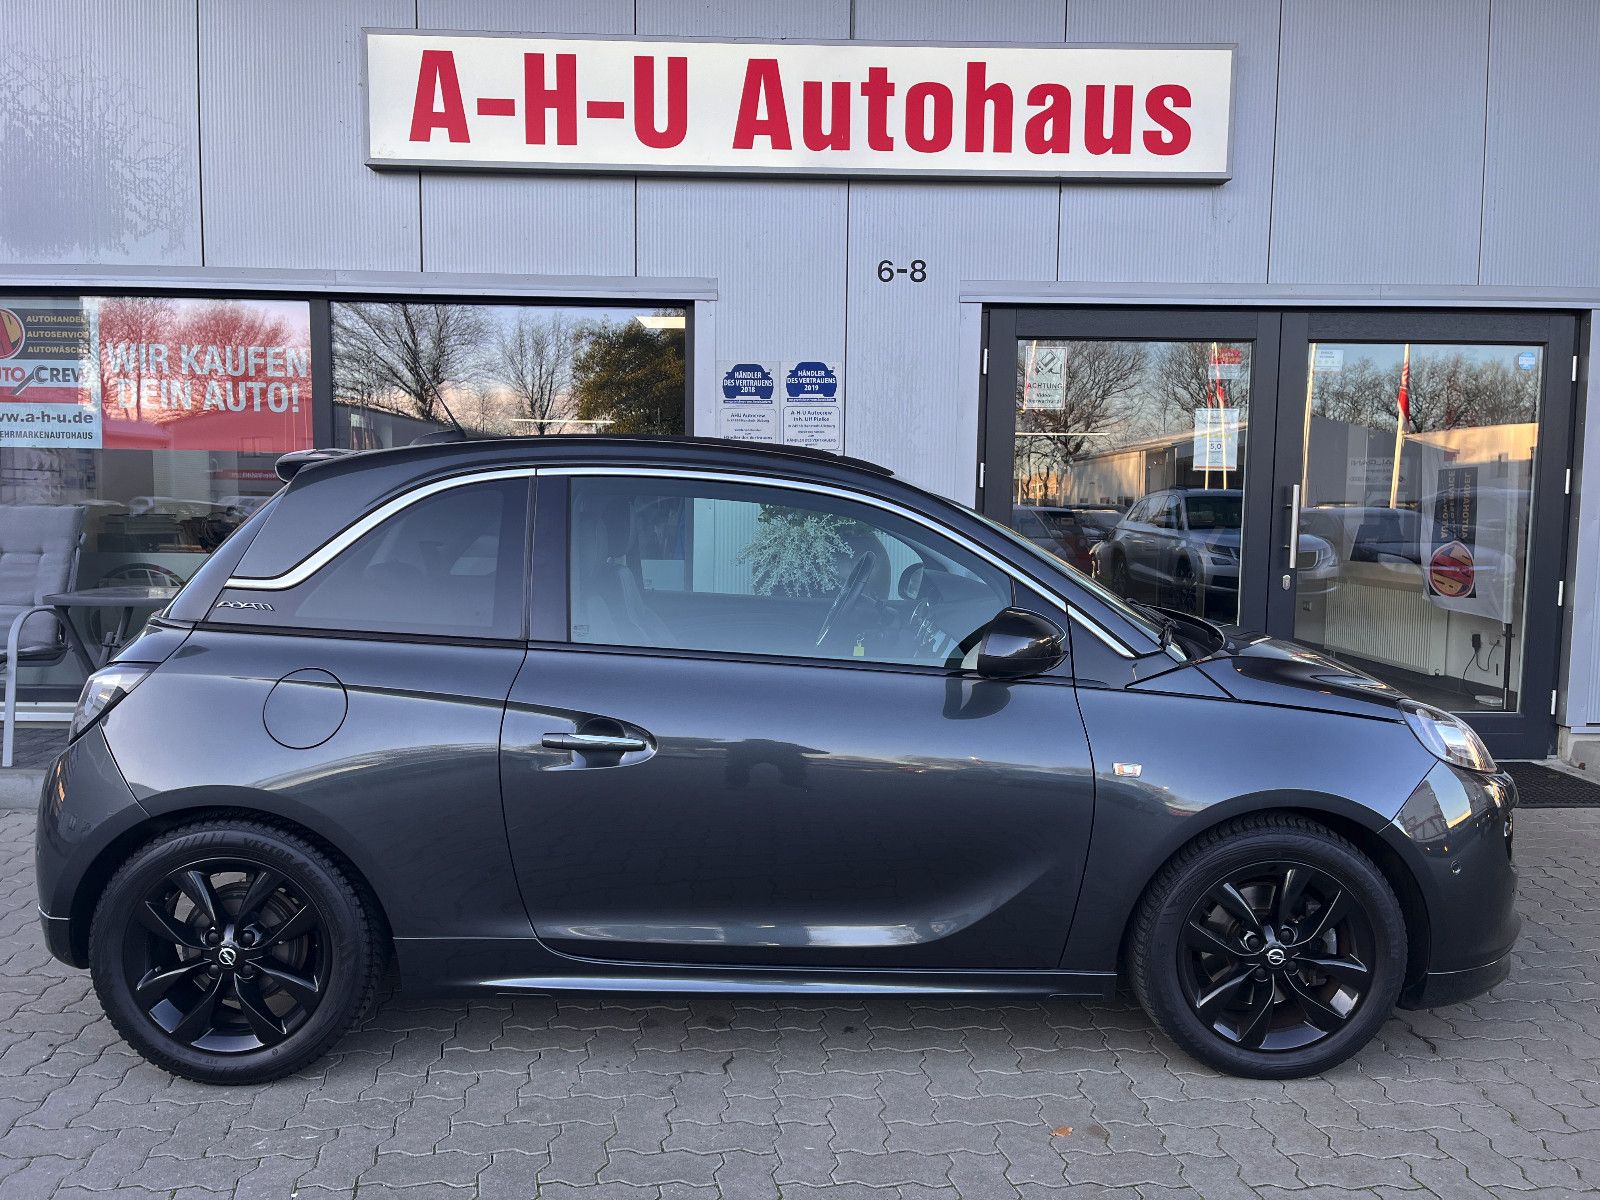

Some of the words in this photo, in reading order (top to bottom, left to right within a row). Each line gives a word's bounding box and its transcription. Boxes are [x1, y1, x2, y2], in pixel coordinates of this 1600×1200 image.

[409, 50, 688, 149] A-H-U
[732, 58, 1192, 155] Autohaus
[877, 259, 927, 282] 6-8
[106, 343, 169, 374] WIR
[180, 344, 307, 378] KAUFEN
[0, 367, 26, 382] TO
[734, 370, 762, 379] HÄNDLER
[797, 369, 825, 377] HÄNDLER
[735, 379, 773, 387] VERTRAUENS
[118, 378, 192, 410] DEIN
[202, 381, 300, 413] AUTO!
[1210, 443, 1222, 451] 5,0
